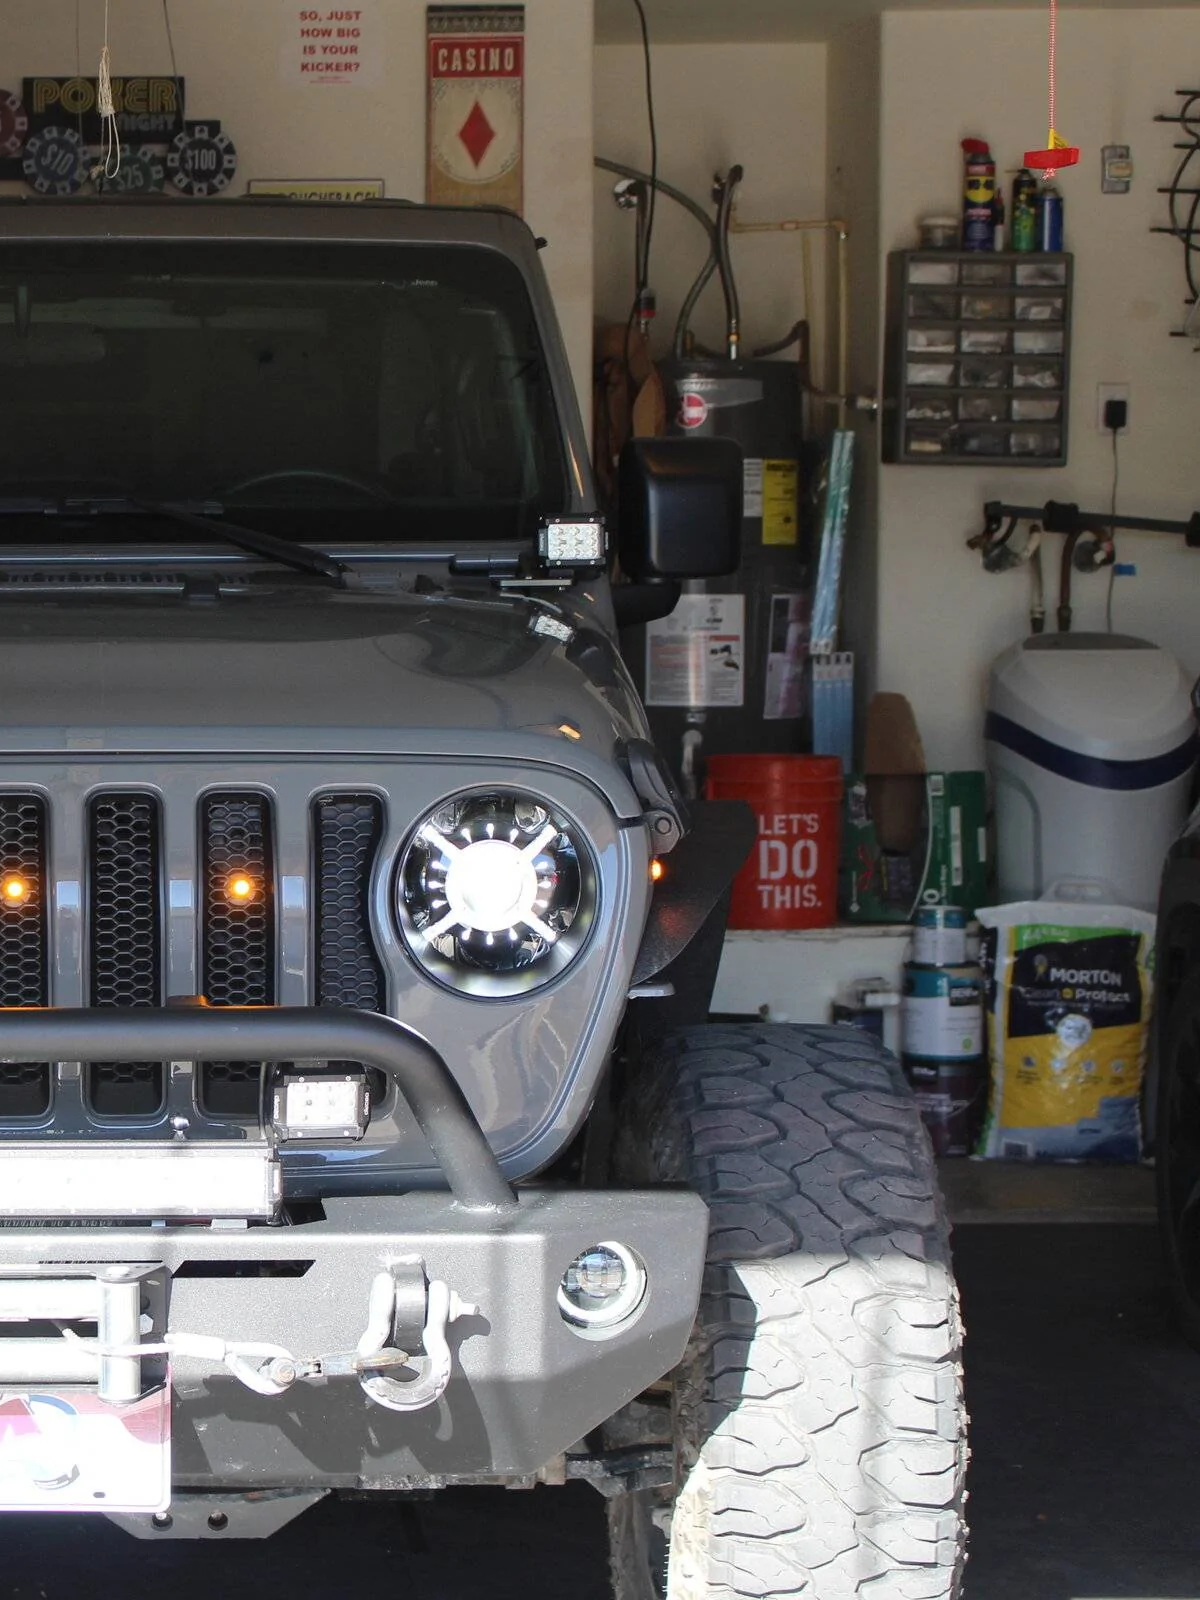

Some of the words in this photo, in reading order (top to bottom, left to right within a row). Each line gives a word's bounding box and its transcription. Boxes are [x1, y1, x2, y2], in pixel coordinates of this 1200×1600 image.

[299, 11, 322, 22] SO,
[326, 11, 362, 21] JUST
[300, 28, 332, 38] HOW
[337, 28, 361, 38] BIG
[303, 45, 316, 55] IS
[320, 45, 358, 55] YOUR
[437, 47, 515, 72] CASINO
[301, 62, 360, 73] KICKER?
[40, 143, 75, 176] $10
[184, 149, 217, 171] $100
[758, 813, 820, 835] LET'S
[759, 838, 819, 880] DO
[757, 883, 823, 909] THIS.
[1050, 967, 1122, 986] MORTON
[1075, 987, 1131, 1003] Protect
